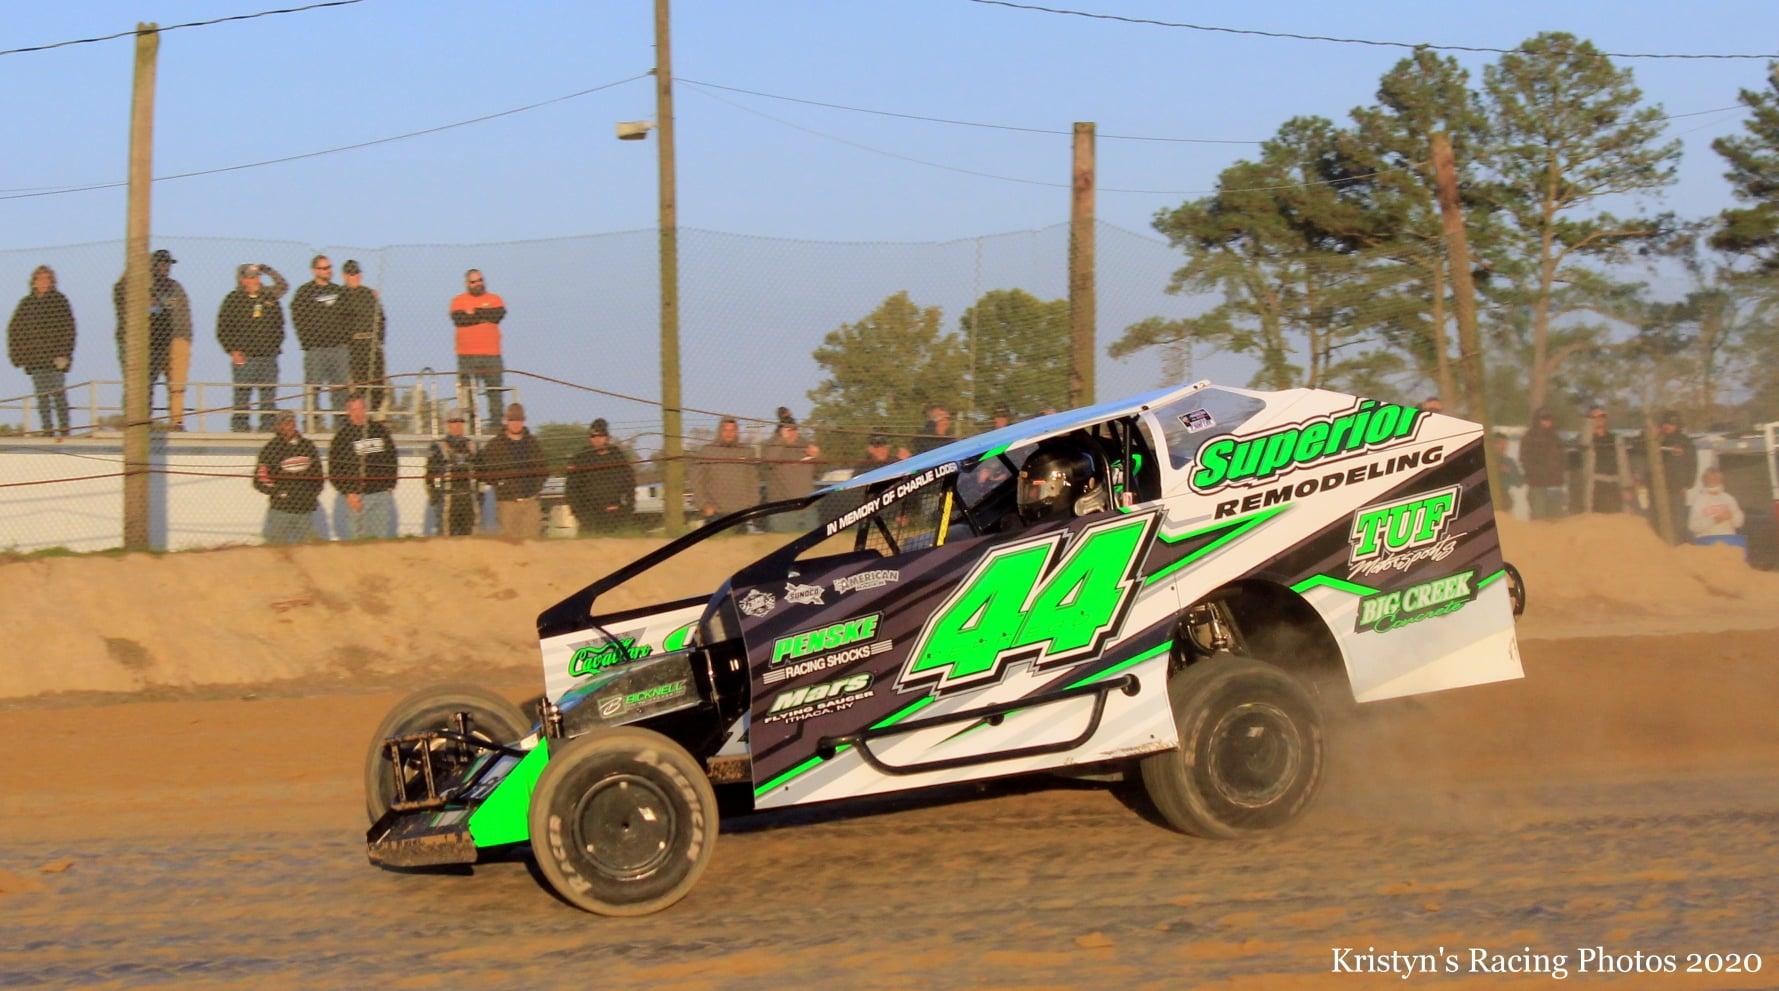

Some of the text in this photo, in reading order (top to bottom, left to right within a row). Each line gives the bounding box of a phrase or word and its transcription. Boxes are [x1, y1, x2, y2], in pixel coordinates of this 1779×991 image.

[1193, 400, 1420, 488] Superior
[826, 521, 838, 536] IN
[838, 498, 880, 530] MEMORY
[882, 490, 896, 506] OF
[896, 470, 935, 498] CHARLIE
[1214, 446, 1444, 520] REMODELING
[1354, 490, 1455, 559] TUF
[1347, 532, 1468, 580] Motorsports
[790, 588, 819, 600] SUNOCO
[840, 571, 898, 590] AMERICAN
[908, 516, 1149, 682] 44
[1360, 570, 1474, 626] BIG CREEK
[771, 614, 879, 663] PENSKE
[785, 646, 871, 679] RACING SHOCKS
[625, 682, 685, 705] BICKNELL
[764, 691, 874, 724] FLYING SAUCER
[769, 674, 870, 714] Mars
[837, 702, 854, 711] NY
